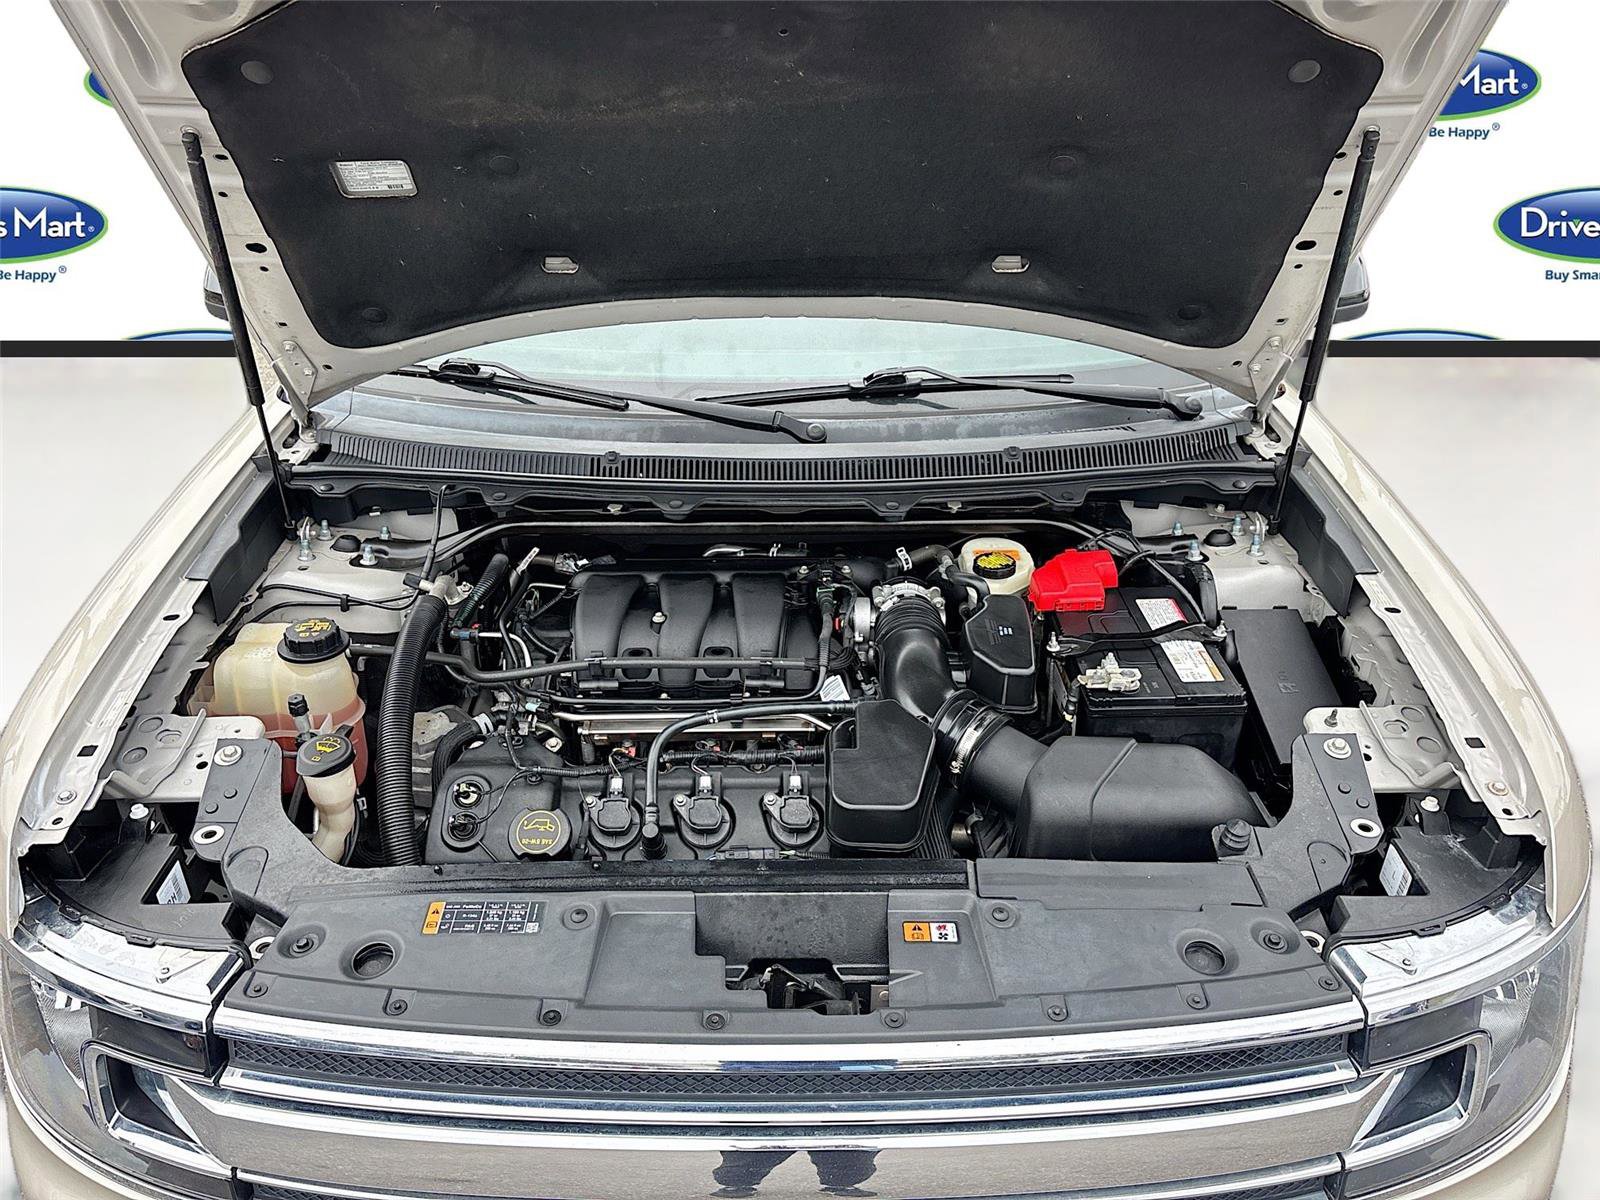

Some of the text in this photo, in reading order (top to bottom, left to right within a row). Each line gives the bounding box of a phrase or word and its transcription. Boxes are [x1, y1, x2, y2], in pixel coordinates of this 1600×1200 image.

[1448, 127, 1490, 140] Happy
[14, 206, 86, 238] Mart
[15, 270, 57, 283] Happy
[1545, 270, 1600, 283] Buy Sma
